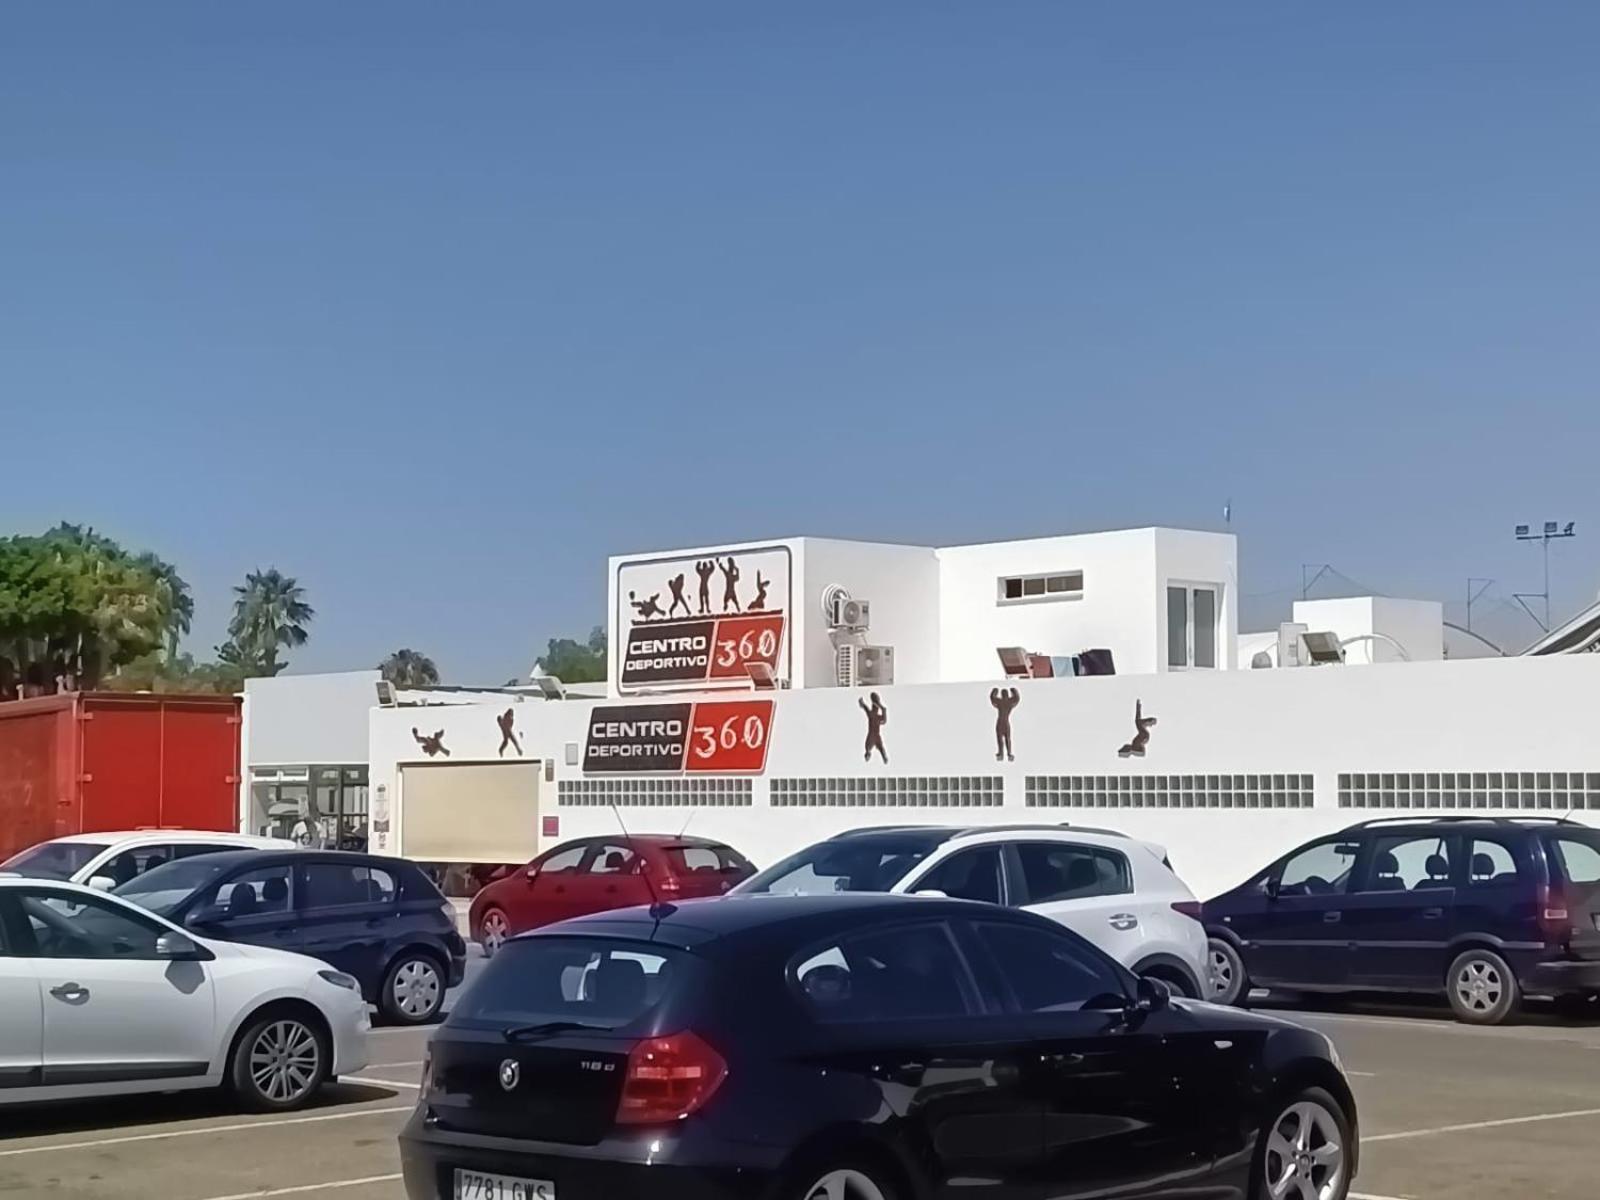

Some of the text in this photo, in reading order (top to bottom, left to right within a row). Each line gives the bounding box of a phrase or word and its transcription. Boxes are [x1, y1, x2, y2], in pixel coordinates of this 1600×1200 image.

[629, 636, 706, 655] CENTRO
[717, 629, 776, 667] 360
[626, 655, 708, 671] DEPORTIVO
[592, 720, 682, 738] CENTRO
[694, 715, 764, 758] 360
[588, 743, 682, 757] DEPORTIVO
[464, 1174, 504, 1200] 7781
